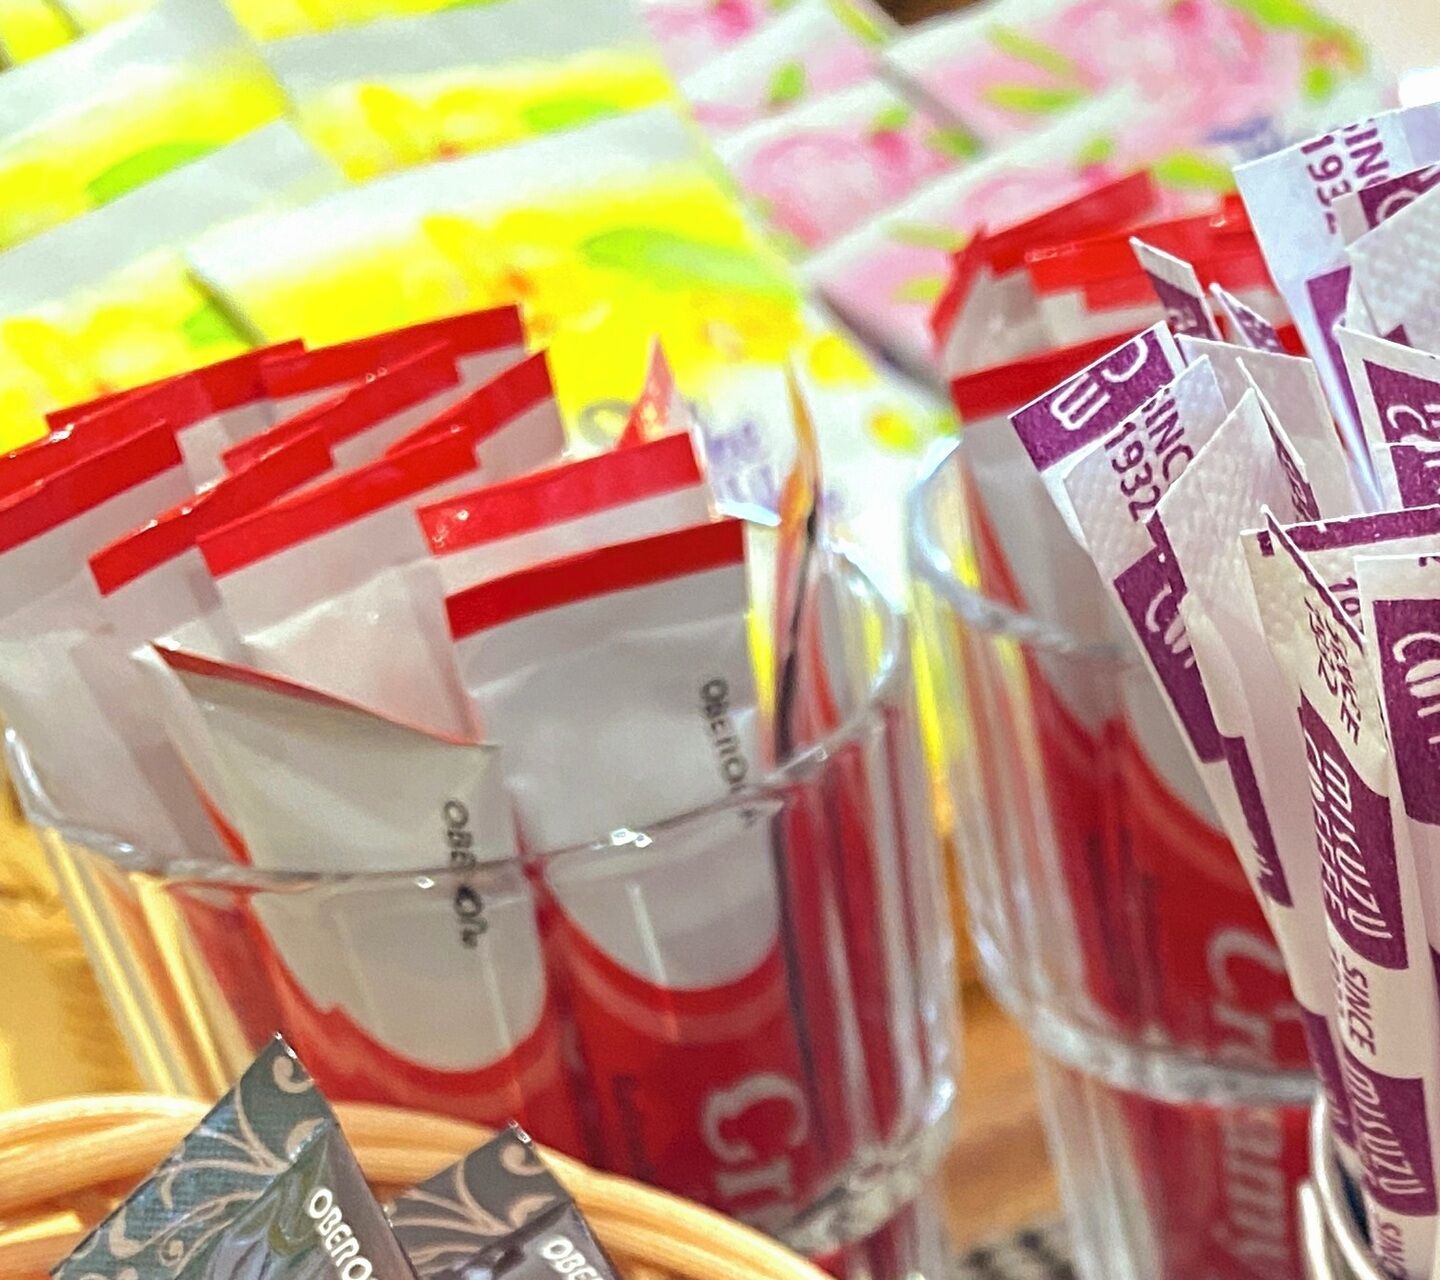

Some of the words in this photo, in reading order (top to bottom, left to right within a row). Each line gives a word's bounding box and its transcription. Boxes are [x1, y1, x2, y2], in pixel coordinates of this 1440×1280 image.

[1104, 421, 1162, 523] 1932
[1322, 749, 1393, 941] MISUZU
[1338, 954, 1377, 1056] SINCE
